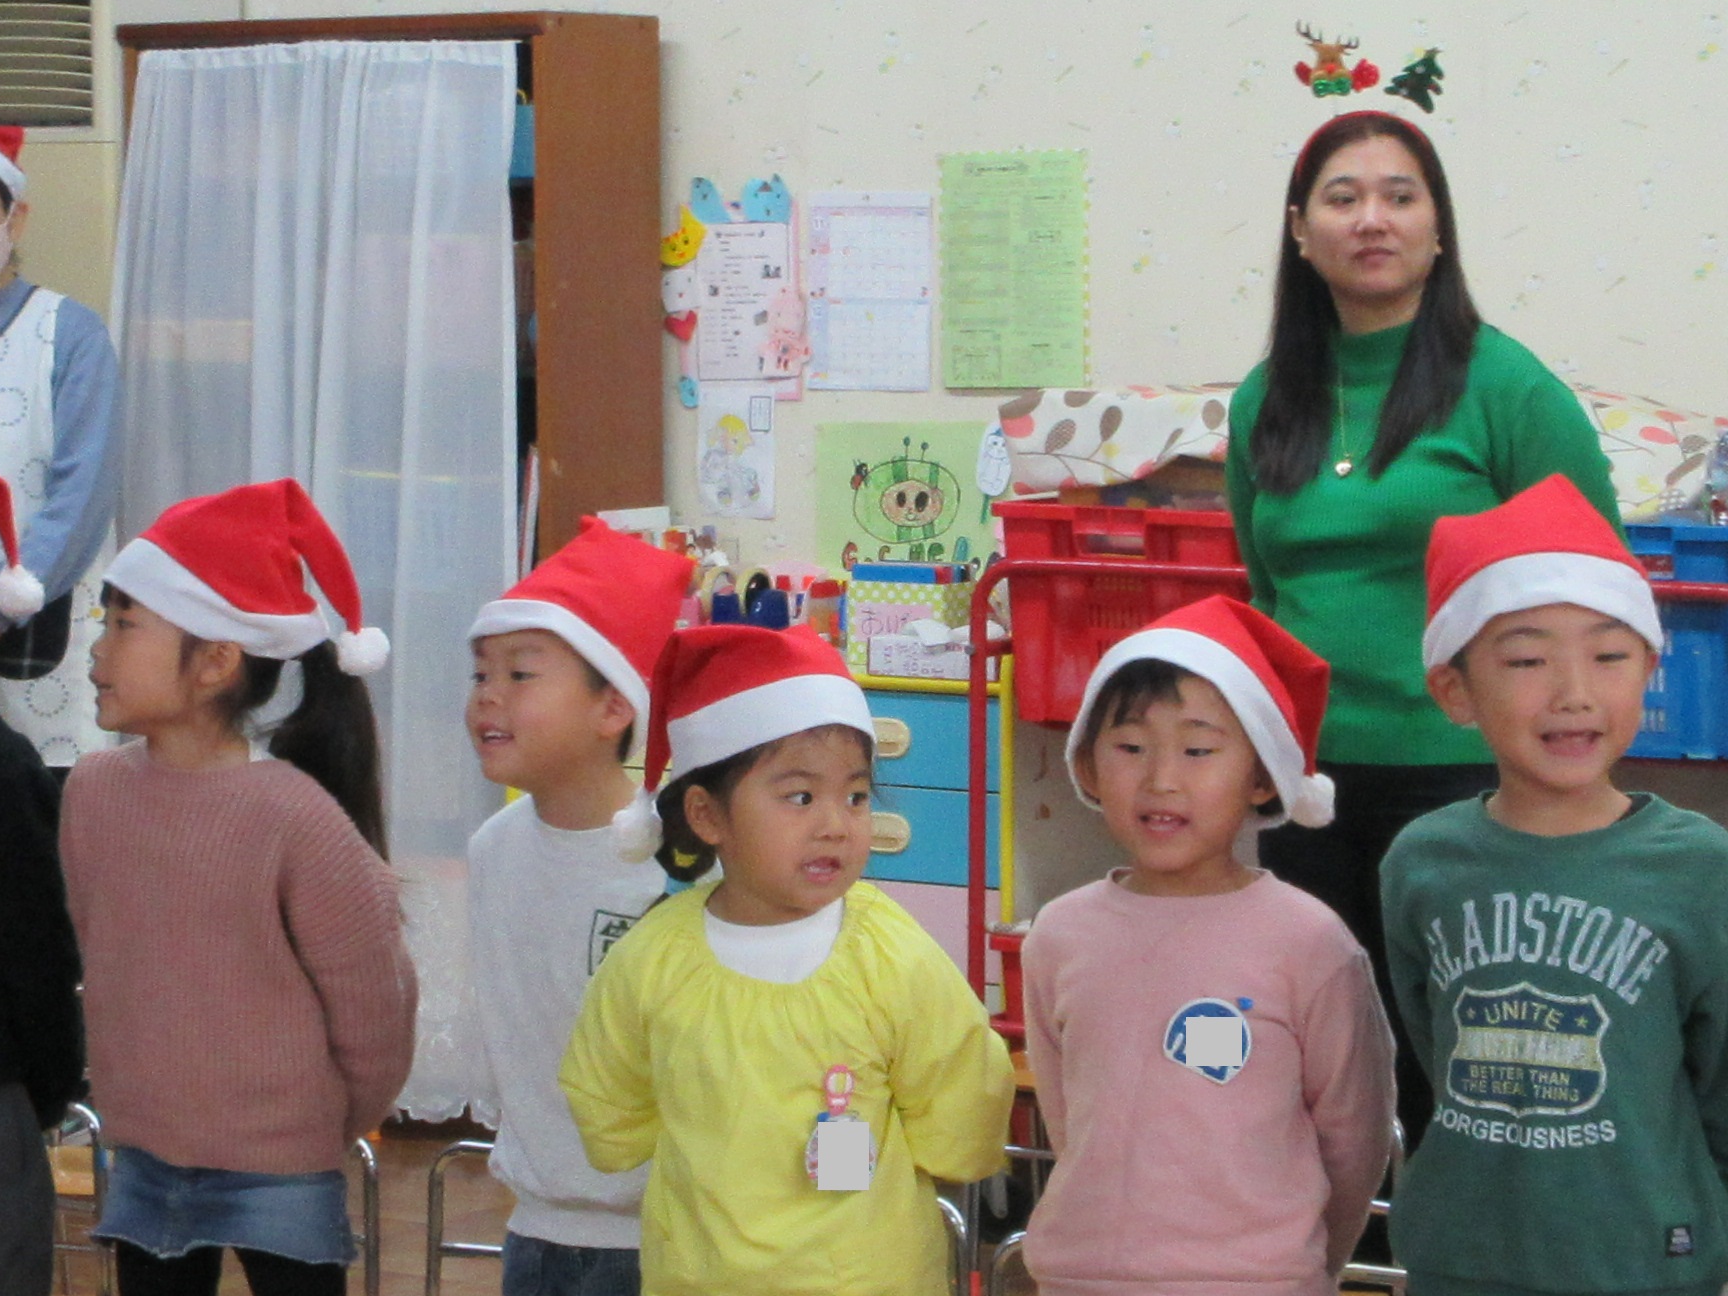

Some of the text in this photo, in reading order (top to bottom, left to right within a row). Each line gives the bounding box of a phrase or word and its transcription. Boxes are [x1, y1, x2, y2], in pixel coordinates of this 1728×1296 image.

[1484, 1000, 1564, 1031] UNITE
[1461, 1079, 1487, 1093] THE
[1469, 1064, 1570, 1086] BETTER THAN
